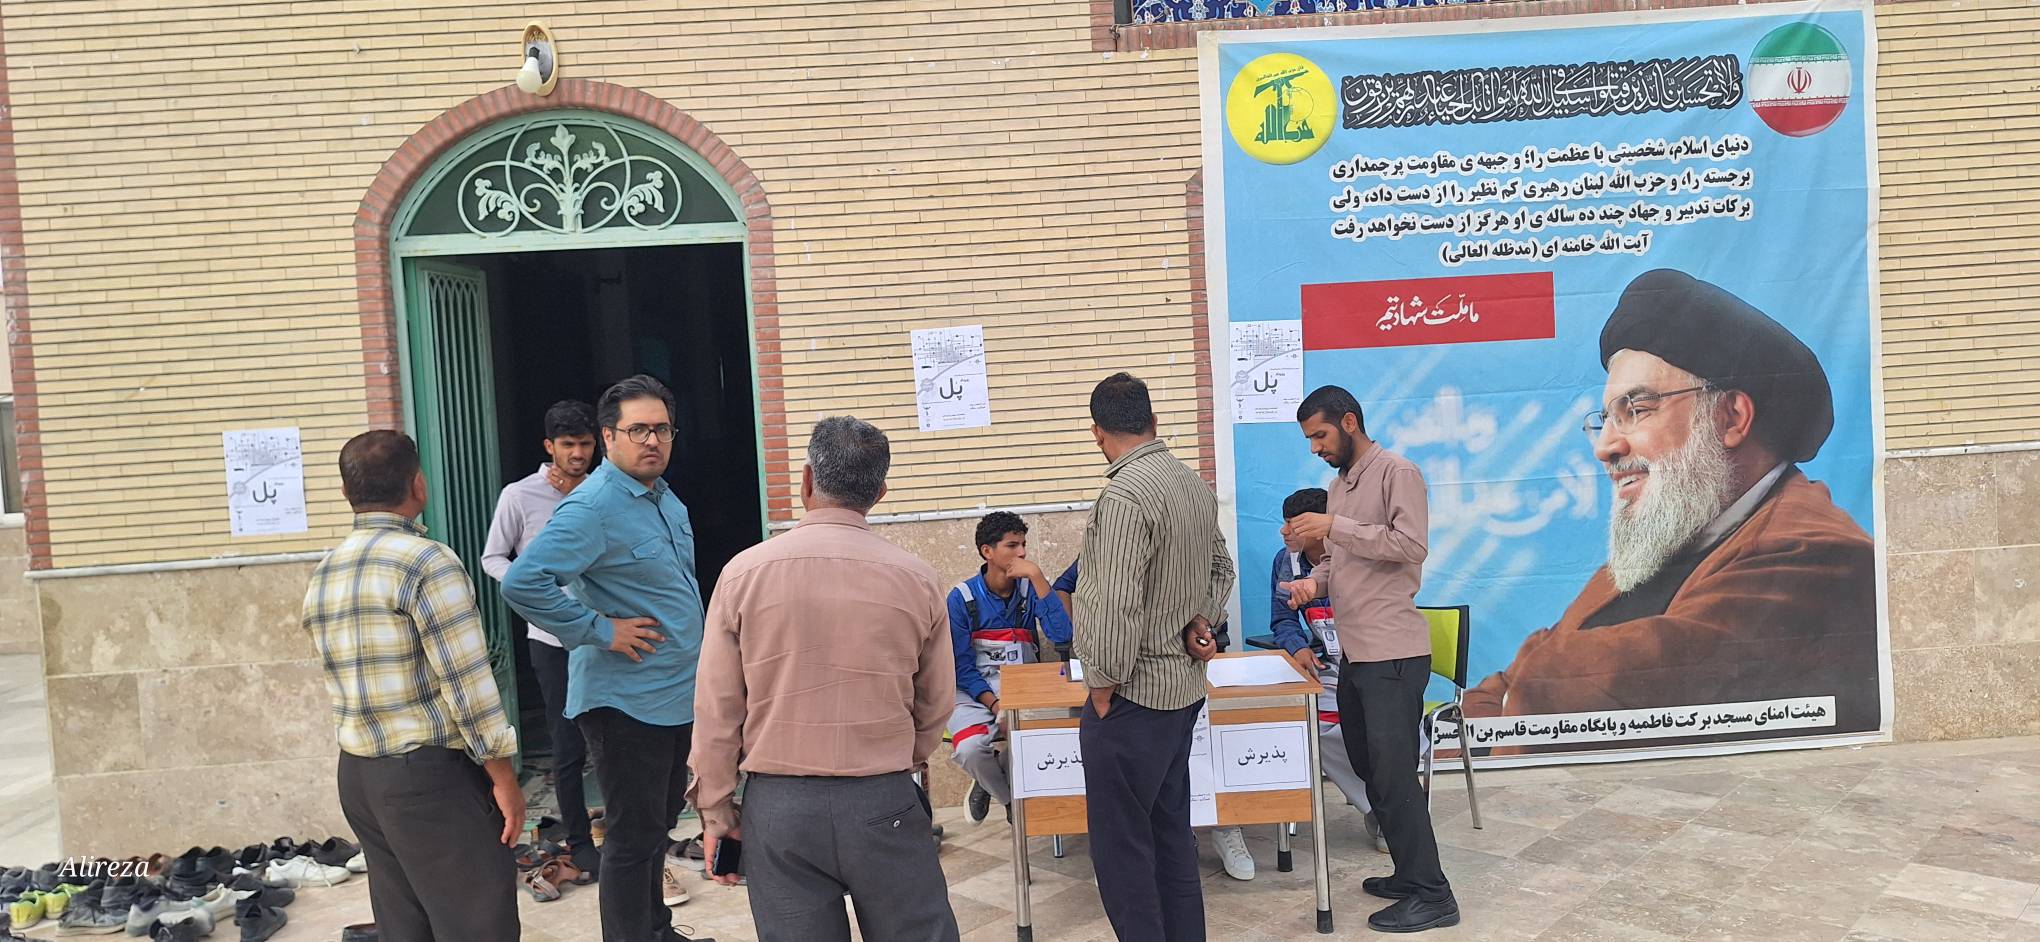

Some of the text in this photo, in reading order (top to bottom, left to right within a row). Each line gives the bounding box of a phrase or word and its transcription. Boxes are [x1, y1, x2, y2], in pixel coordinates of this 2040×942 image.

[1547, 148, 1590, 162] عظمت
[1594, 145, 1604, 162] با
[1608, 141, 1665, 163] شخصیتی
[1669, 139, 1707, 160] اسلام،
[1711, 136, 1749, 158] دنیای
[1407, 154, 1456, 175] مقاومت
[1477, 153, 1508, 170] جبهه
[1513, 157, 1521, 170] و
[1572, 175, 1604, 195] لبنان
[1608, 171, 1630, 189] الله
[1634, 174, 1665, 192] حزب
[1670, 177, 1677, 190] و
[1703, 170, 1750, 187] برجسته
[1333, 189, 1360, 208] ولی
[1396, 190, 1430, 202] دست
[1434, 186, 1447, 204] از
[1451, 184, 1464, 202] را
[1468, 182, 1498, 201] نظیر
[1501, 181, 1519, 199] کم
[1523, 182, 1568, 200] رهبری
[1546, 208, 1575, 223] ساله
[1578, 209, 1595, 221] ده
[1598, 207, 1625, 225] چند
[1628, 203, 1660, 223] جهاد
[1664, 208, 1672, 221] و
[1675, 200, 1710, 221] تدبیر
[1712, 198, 1750, 218] برکات
[1334, 219, 1363, 238] رفت
[1367, 216, 1416, 237] نخواهد
[1420, 217, 1454, 230] دست
[1458, 214, 1471, 232] از
[1474, 212, 1509, 232] هرگز
[1513, 211, 1525, 229] او
[1541, 240, 1558, 257] ای
[1561, 237, 1596, 253] خامنه
[1599, 233, 1620, 252] الله
[1623, 233, 1650, 253] آیت
[1469, 301, 1480, 323] ما
[939, 377, 963, 401] پل
[1253, 371, 1278, 395] پل
[252, 481, 277, 505] پل
[1675, 712, 1711, 731] برکت
[1713, 713, 1753, 728] مسجد
[1754, 705, 1789, 726] امنای
[1790, 703, 1826, 722] هیئت
[1495, 720, 1526, 742] قاسم
[1528, 719, 1578, 739] مقاومت
[1579, 717, 1617, 737] پایگاه
[1619, 721, 1626, 734] و
[1627, 711, 1674, 734] فاطمیه
[1476, 725, 1493, 743] بن
[1237, 745, 1288, 766] پذیرش
